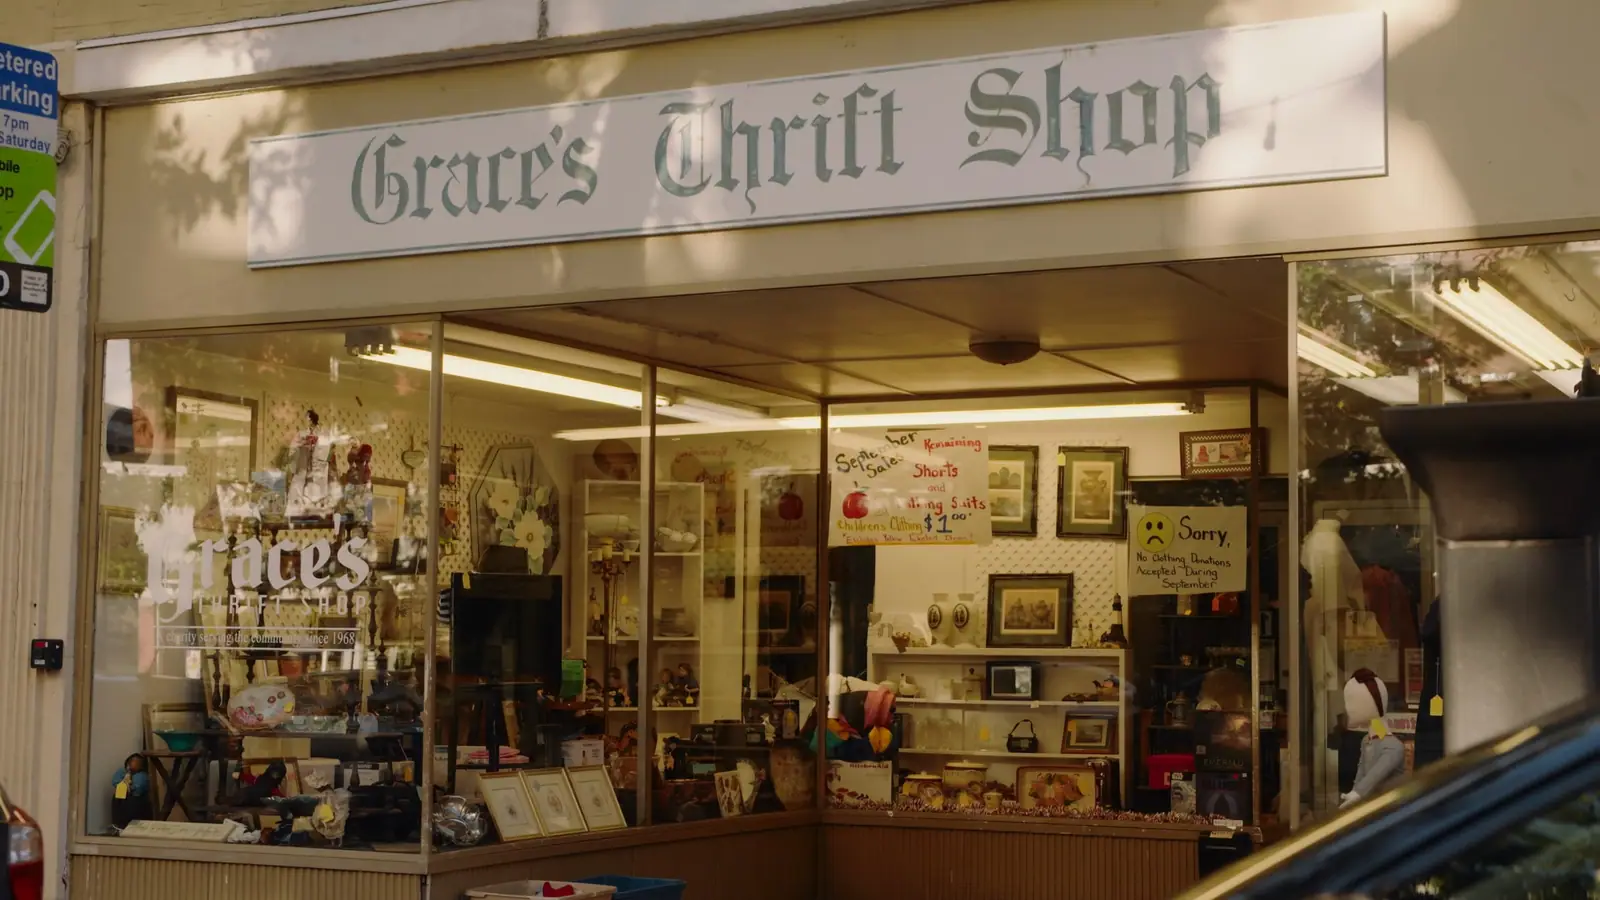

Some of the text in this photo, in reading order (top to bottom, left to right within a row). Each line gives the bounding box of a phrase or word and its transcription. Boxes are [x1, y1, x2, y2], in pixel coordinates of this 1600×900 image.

[4, 114, 29, 132] 7pm
[352, 60, 1222, 224] Grace's Thrift Shop
[924, 436, 981, 456] Remaining
[913, 461, 958, 478] Shorts
[928, 482, 945, 493] and
[1178, 515, 1230, 548] Sorry,
[1136, 552, 1231, 568] No Clothing Donations
[1136, 566, 1218, 580] Accepted During
[1162, 578, 1217, 592] September
[198, 594, 366, 616] THRIFT SHOP
[166, 630, 196, 645] chrity
[332, 631, 355, 645] 1968
